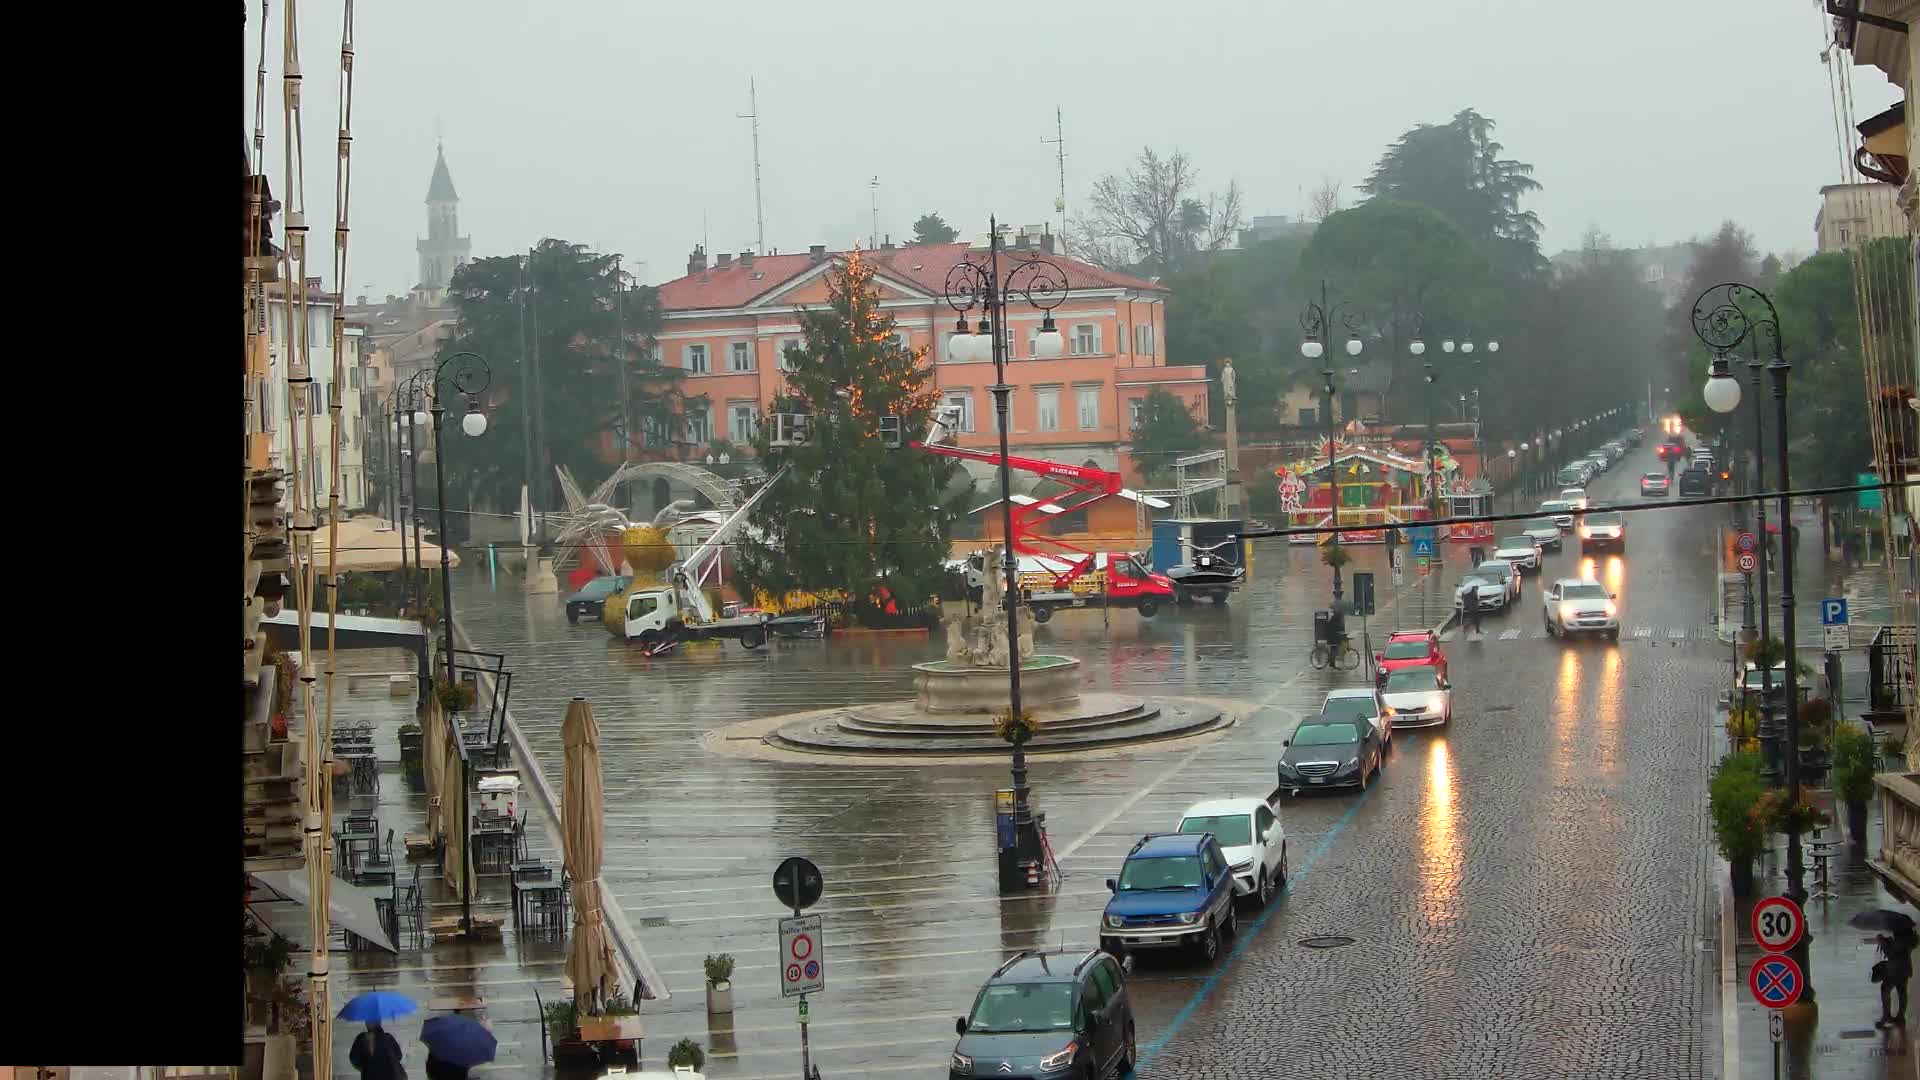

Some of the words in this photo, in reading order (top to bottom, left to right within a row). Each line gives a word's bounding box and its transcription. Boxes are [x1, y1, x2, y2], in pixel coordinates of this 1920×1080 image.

[1742, 557, 1752, 567] 20
[1827, 602, 1842, 622] P
[1762, 911, 1791, 938] 30
